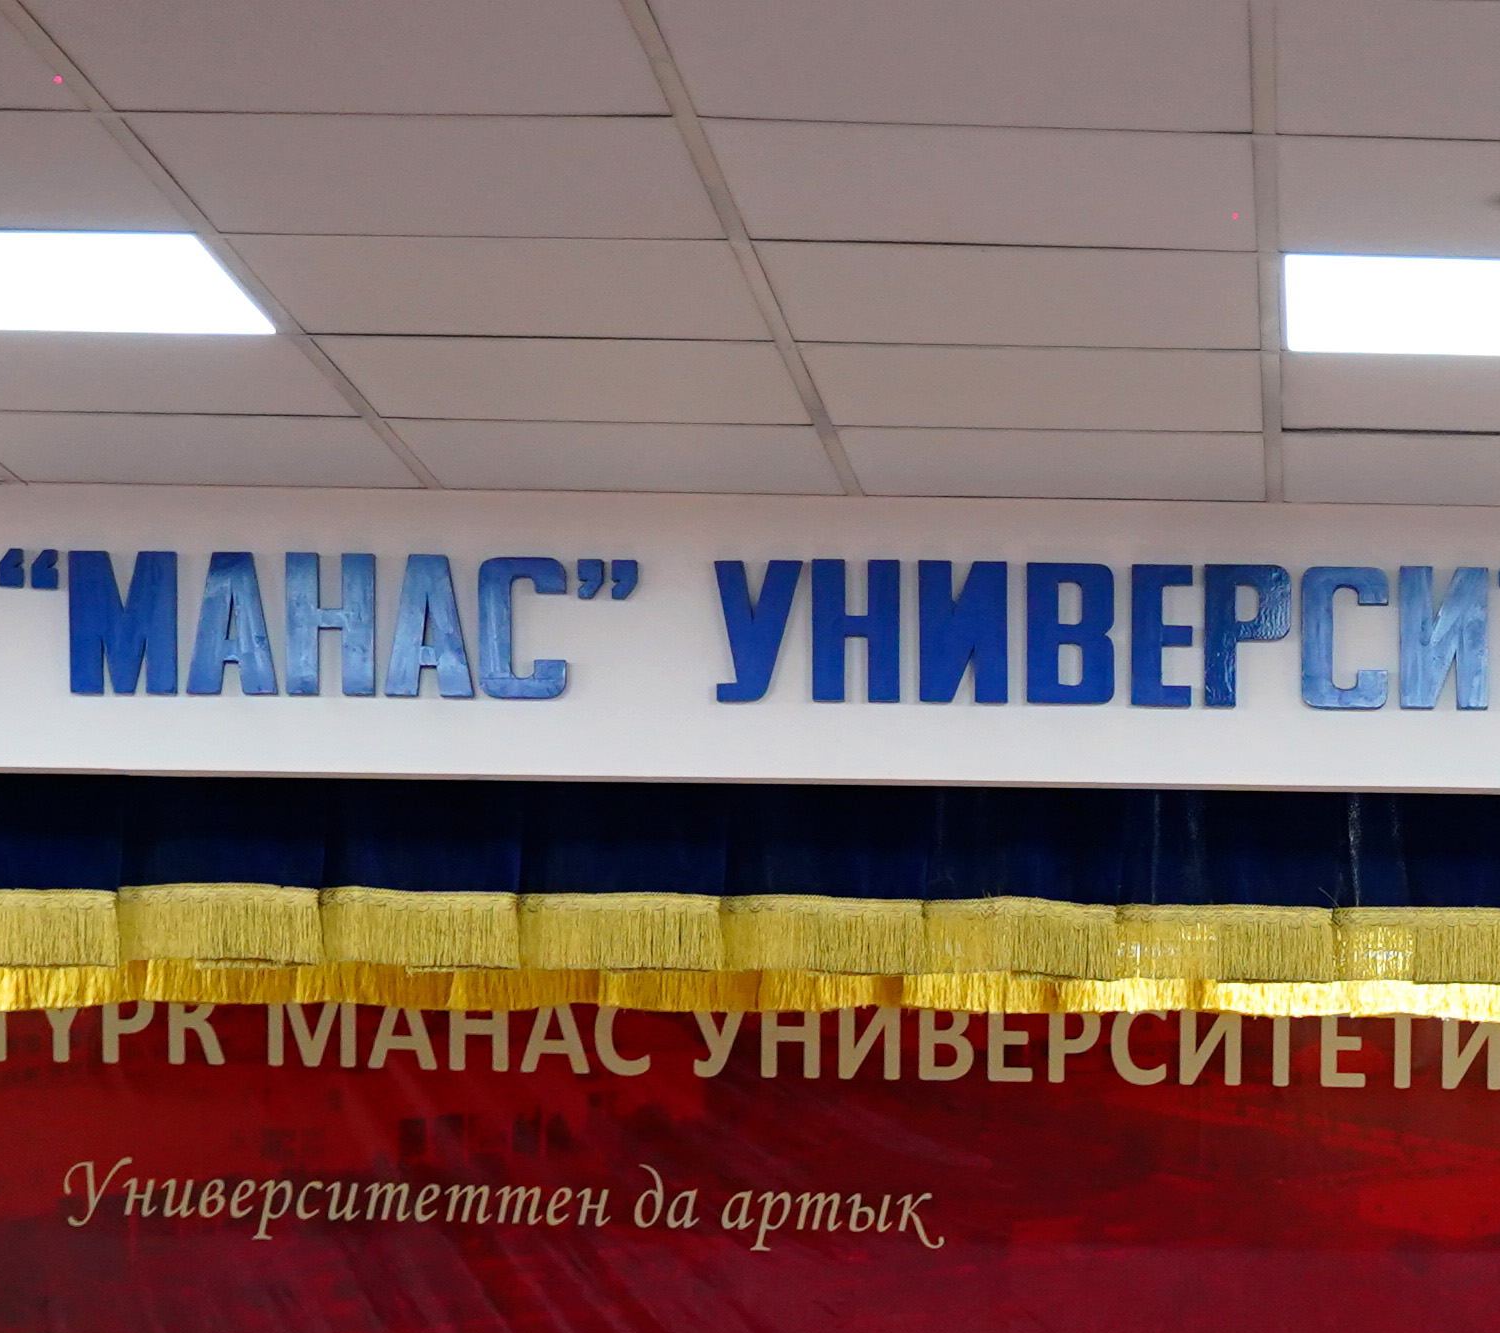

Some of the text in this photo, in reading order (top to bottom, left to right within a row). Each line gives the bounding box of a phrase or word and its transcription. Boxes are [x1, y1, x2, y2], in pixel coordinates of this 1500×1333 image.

[266, 1002, 651, 1077] МАНАС
[63, 1156, 946, 1251] Университеттен да артык
